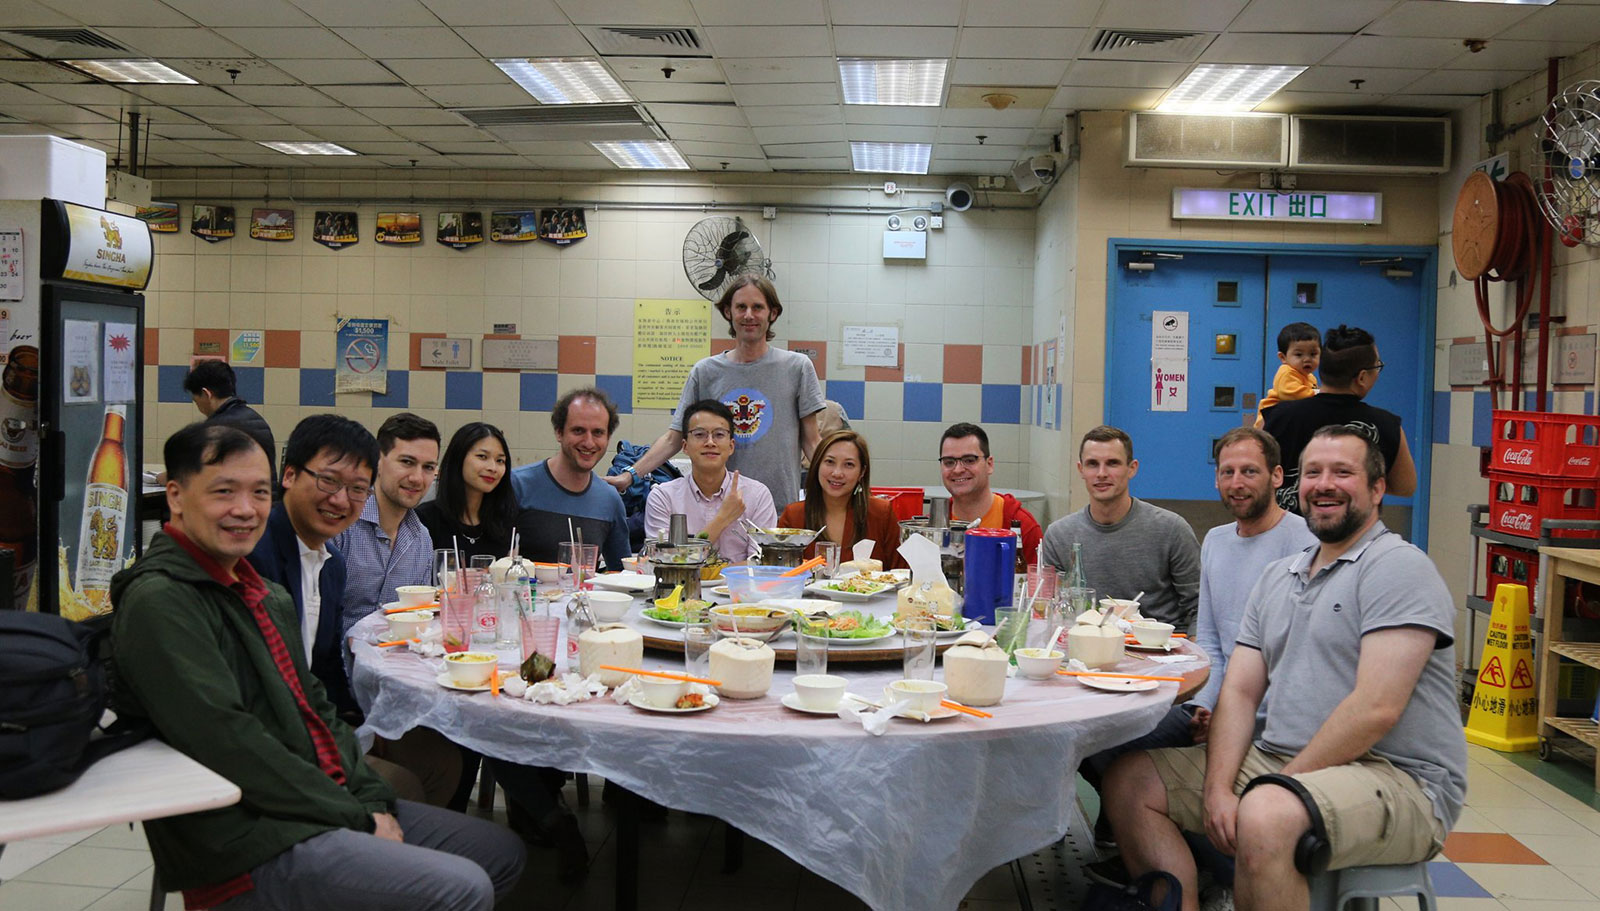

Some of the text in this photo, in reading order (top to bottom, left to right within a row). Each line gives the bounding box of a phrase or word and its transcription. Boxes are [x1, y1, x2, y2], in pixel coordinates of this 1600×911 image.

[1229, 193, 1327, 217] EXIT 出口
[96, 248, 126, 264] SINGHA
[1, 310, 7, 319] 9
[1155, 373, 1185, 382] WOMEN
[1169, 386, 1177, 397] 女
[1503, 447, 1533, 465] Coca-Cola
[1567, 456, 1591, 466] Coca-Cola
[1500, 511, 1533, 531] Coca-Cola
[1489, 630, 1507, 640] CAUTION
[1487, 638, 1508, 649] WET FLOOR
[1474, 691, 1506, 716] 小心地滑
